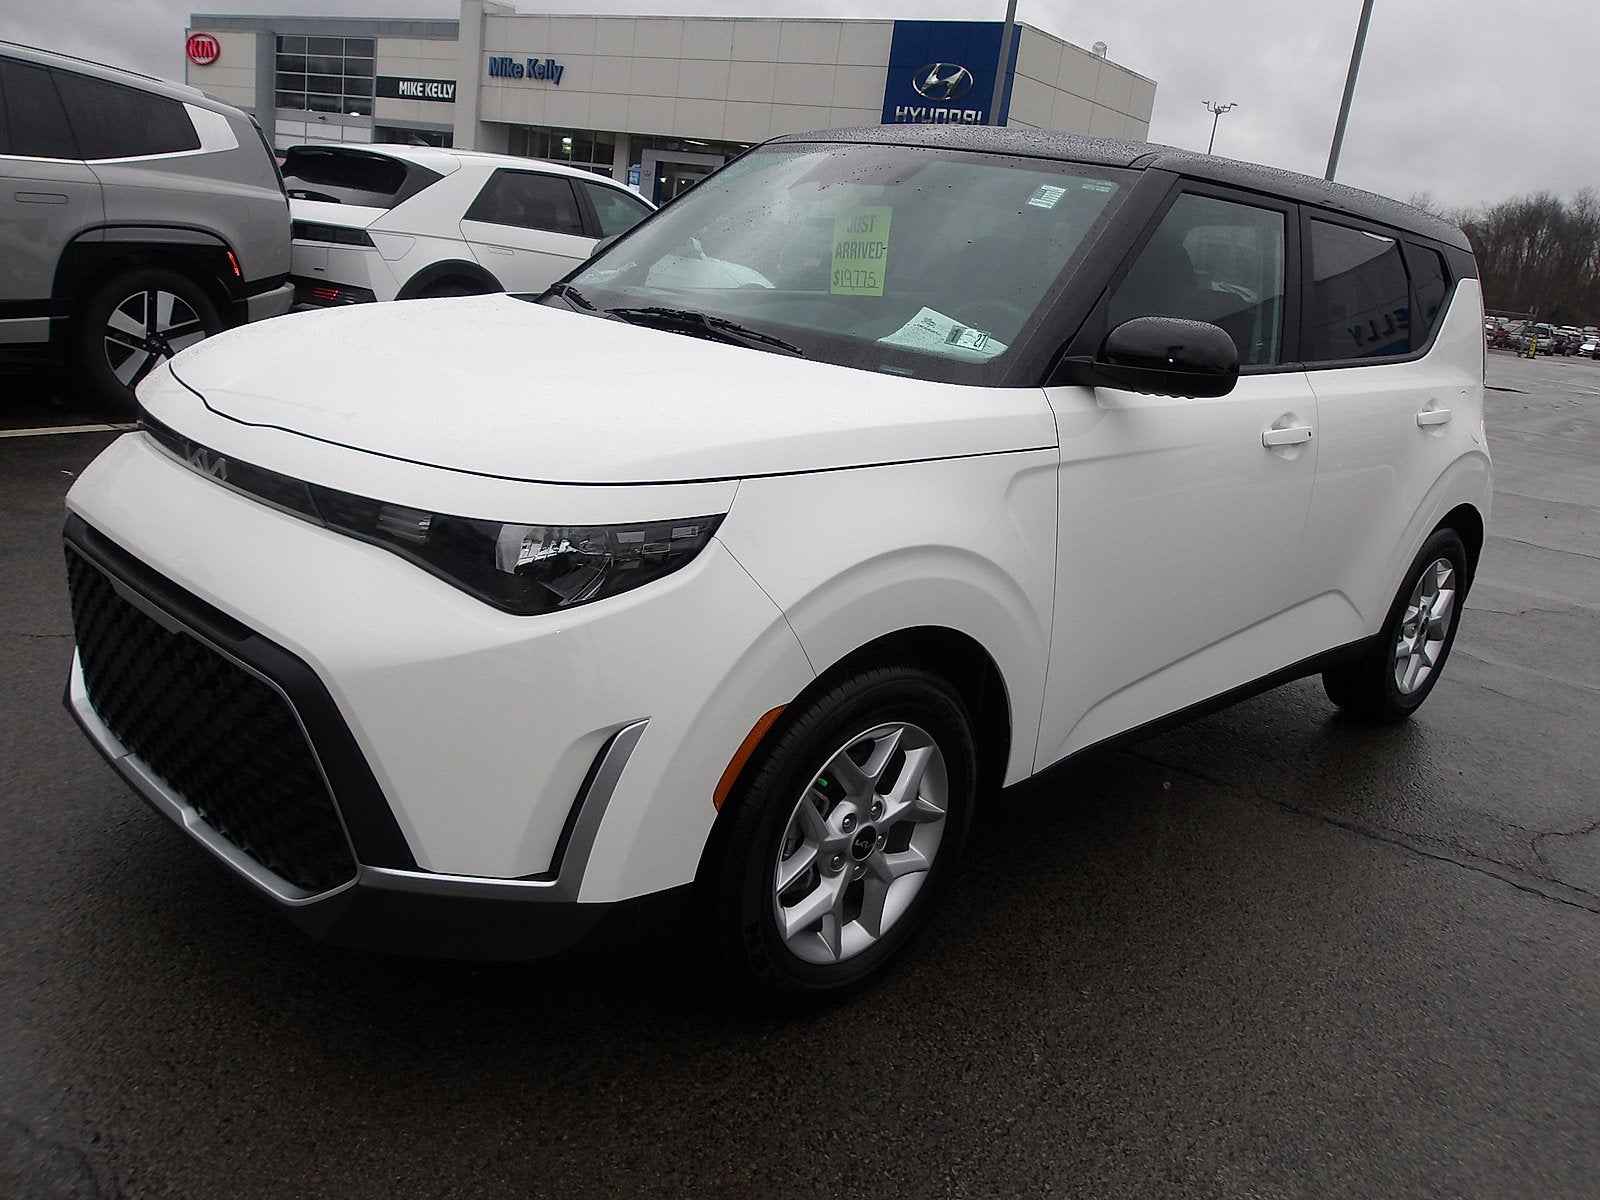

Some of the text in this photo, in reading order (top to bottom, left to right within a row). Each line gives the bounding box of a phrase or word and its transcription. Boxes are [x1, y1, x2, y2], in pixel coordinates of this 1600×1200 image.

[488, 56, 564, 85] Mike Kelly
[399, 81, 454, 98] MIKE KELLY
[894, 106, 982, 124] HYUNDAI
[847, 215, 876, 233] JUST
[835, 242, 883, 259] ARRIVED
[973, 333, 987, 348] 27
